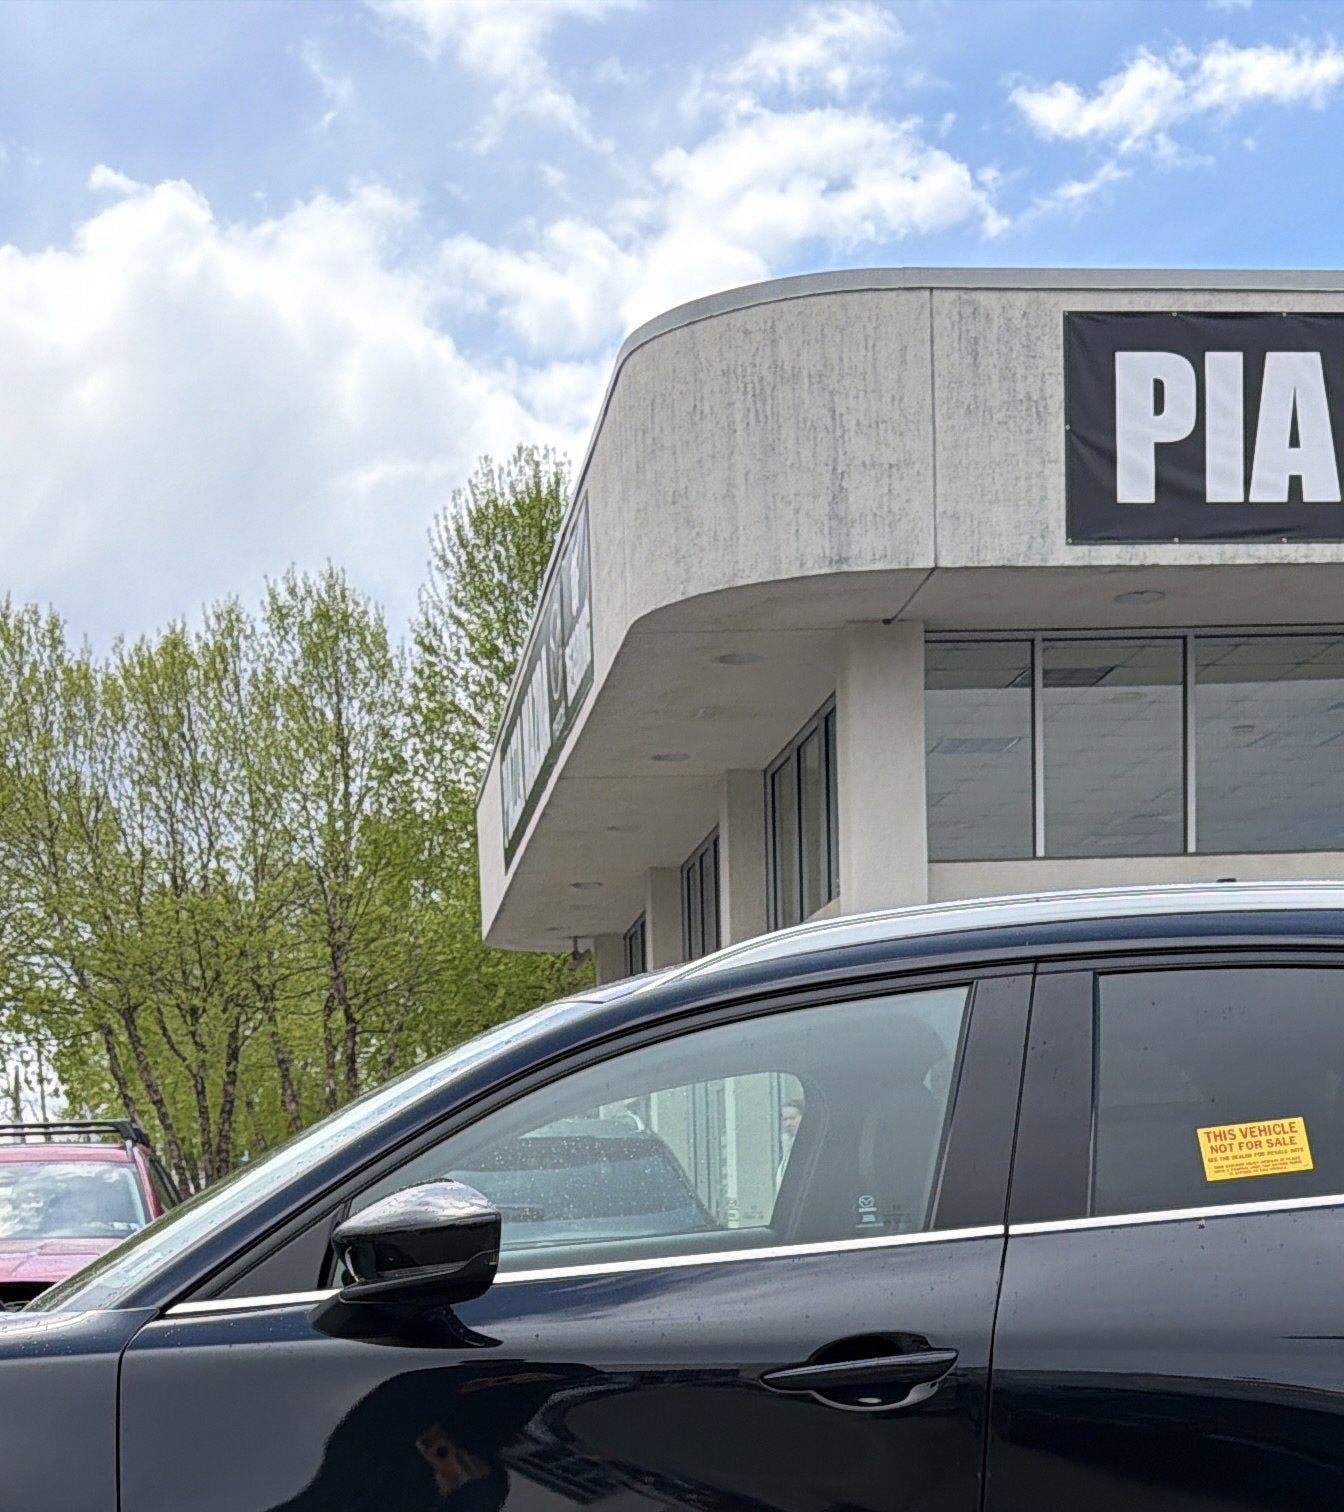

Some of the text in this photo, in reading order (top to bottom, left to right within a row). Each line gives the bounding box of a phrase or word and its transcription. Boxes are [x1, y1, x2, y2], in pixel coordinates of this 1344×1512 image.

[1203, 1122, 1299, 1143] THIS VEHICLE
[1210, 1135, 1298, 1155] NOT FOR SALE
